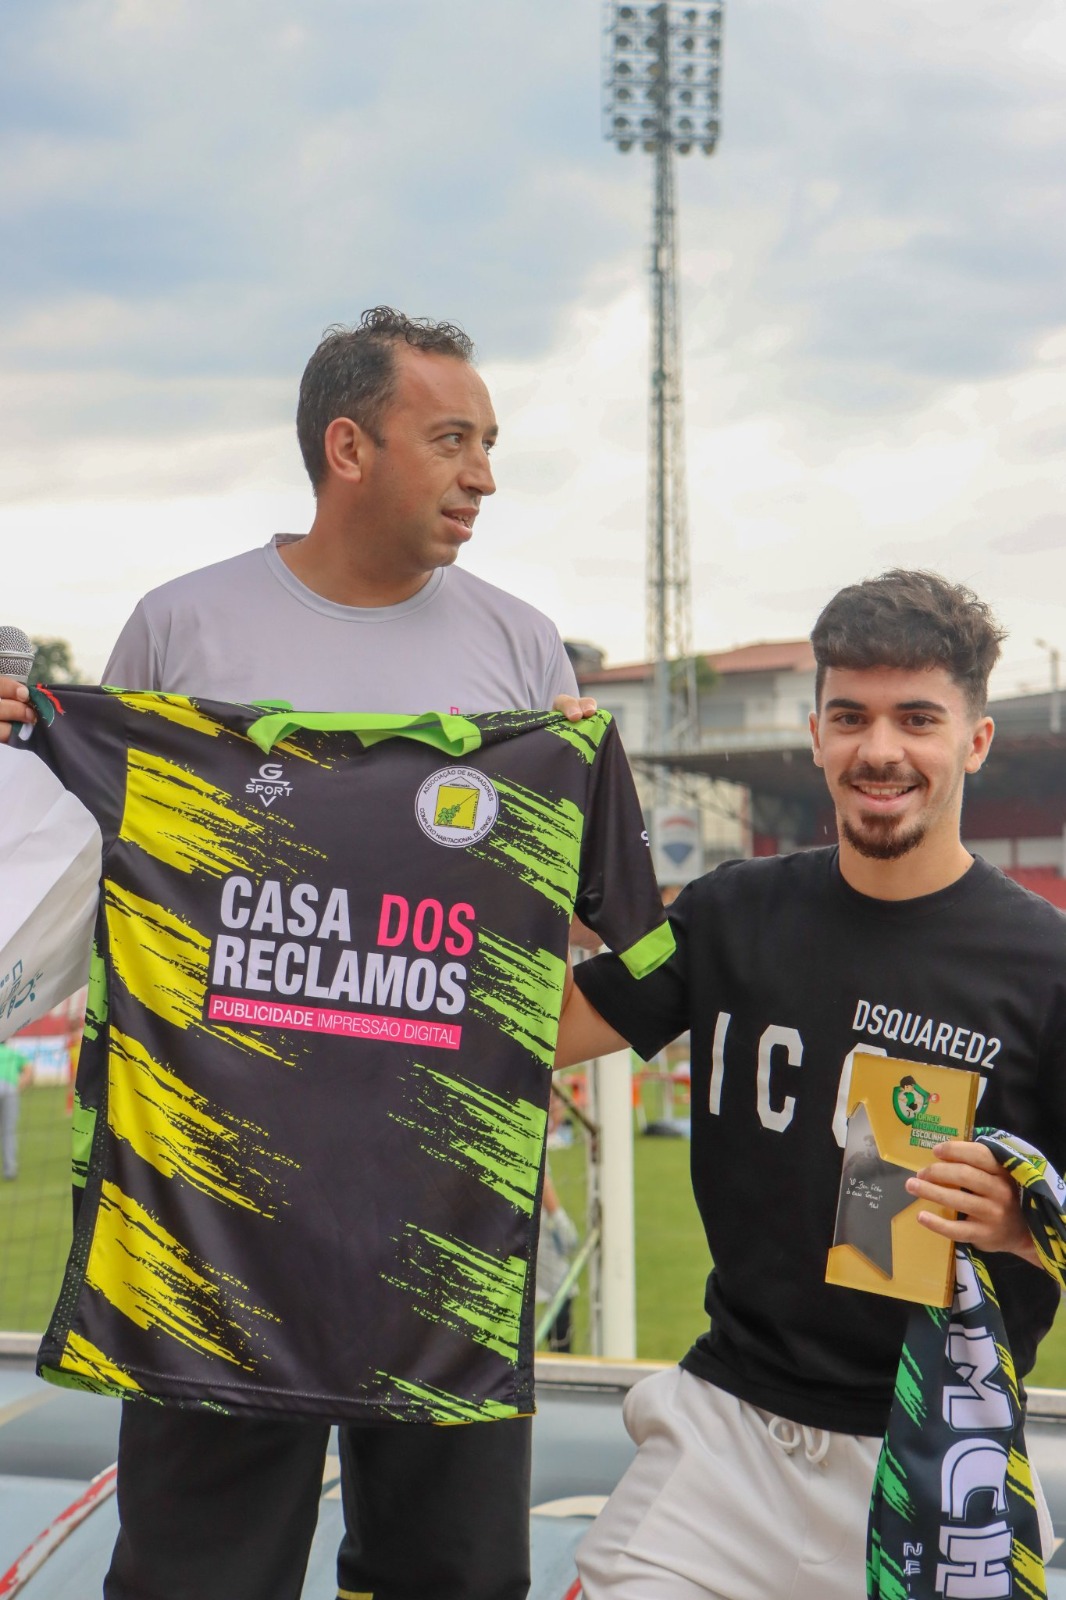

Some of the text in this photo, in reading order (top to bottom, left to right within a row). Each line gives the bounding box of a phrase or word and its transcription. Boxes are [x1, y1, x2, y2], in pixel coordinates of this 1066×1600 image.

[245, 783, 294, 797] SPORT
[423, 769, 457, 794] ASSOCIAÇÃO
[467, 771, 494, 802] MORADORES
[419, 807, 437, 836] COMPLEXO
[435, 832, 474, 844] HABITACIONAL
[473, 830, 481, 838] DE
[480, 815, 493, 833] RINGE
[220, 875, 477, 957] CASA DOS
[211, 933, 468, 1016] RECLAMOS
[212, 1000, 457, 1046] PUBLICIDADE IMPRESSÃO DIGITAL
[851, 999, 1002, 1070] DSQUARED2
